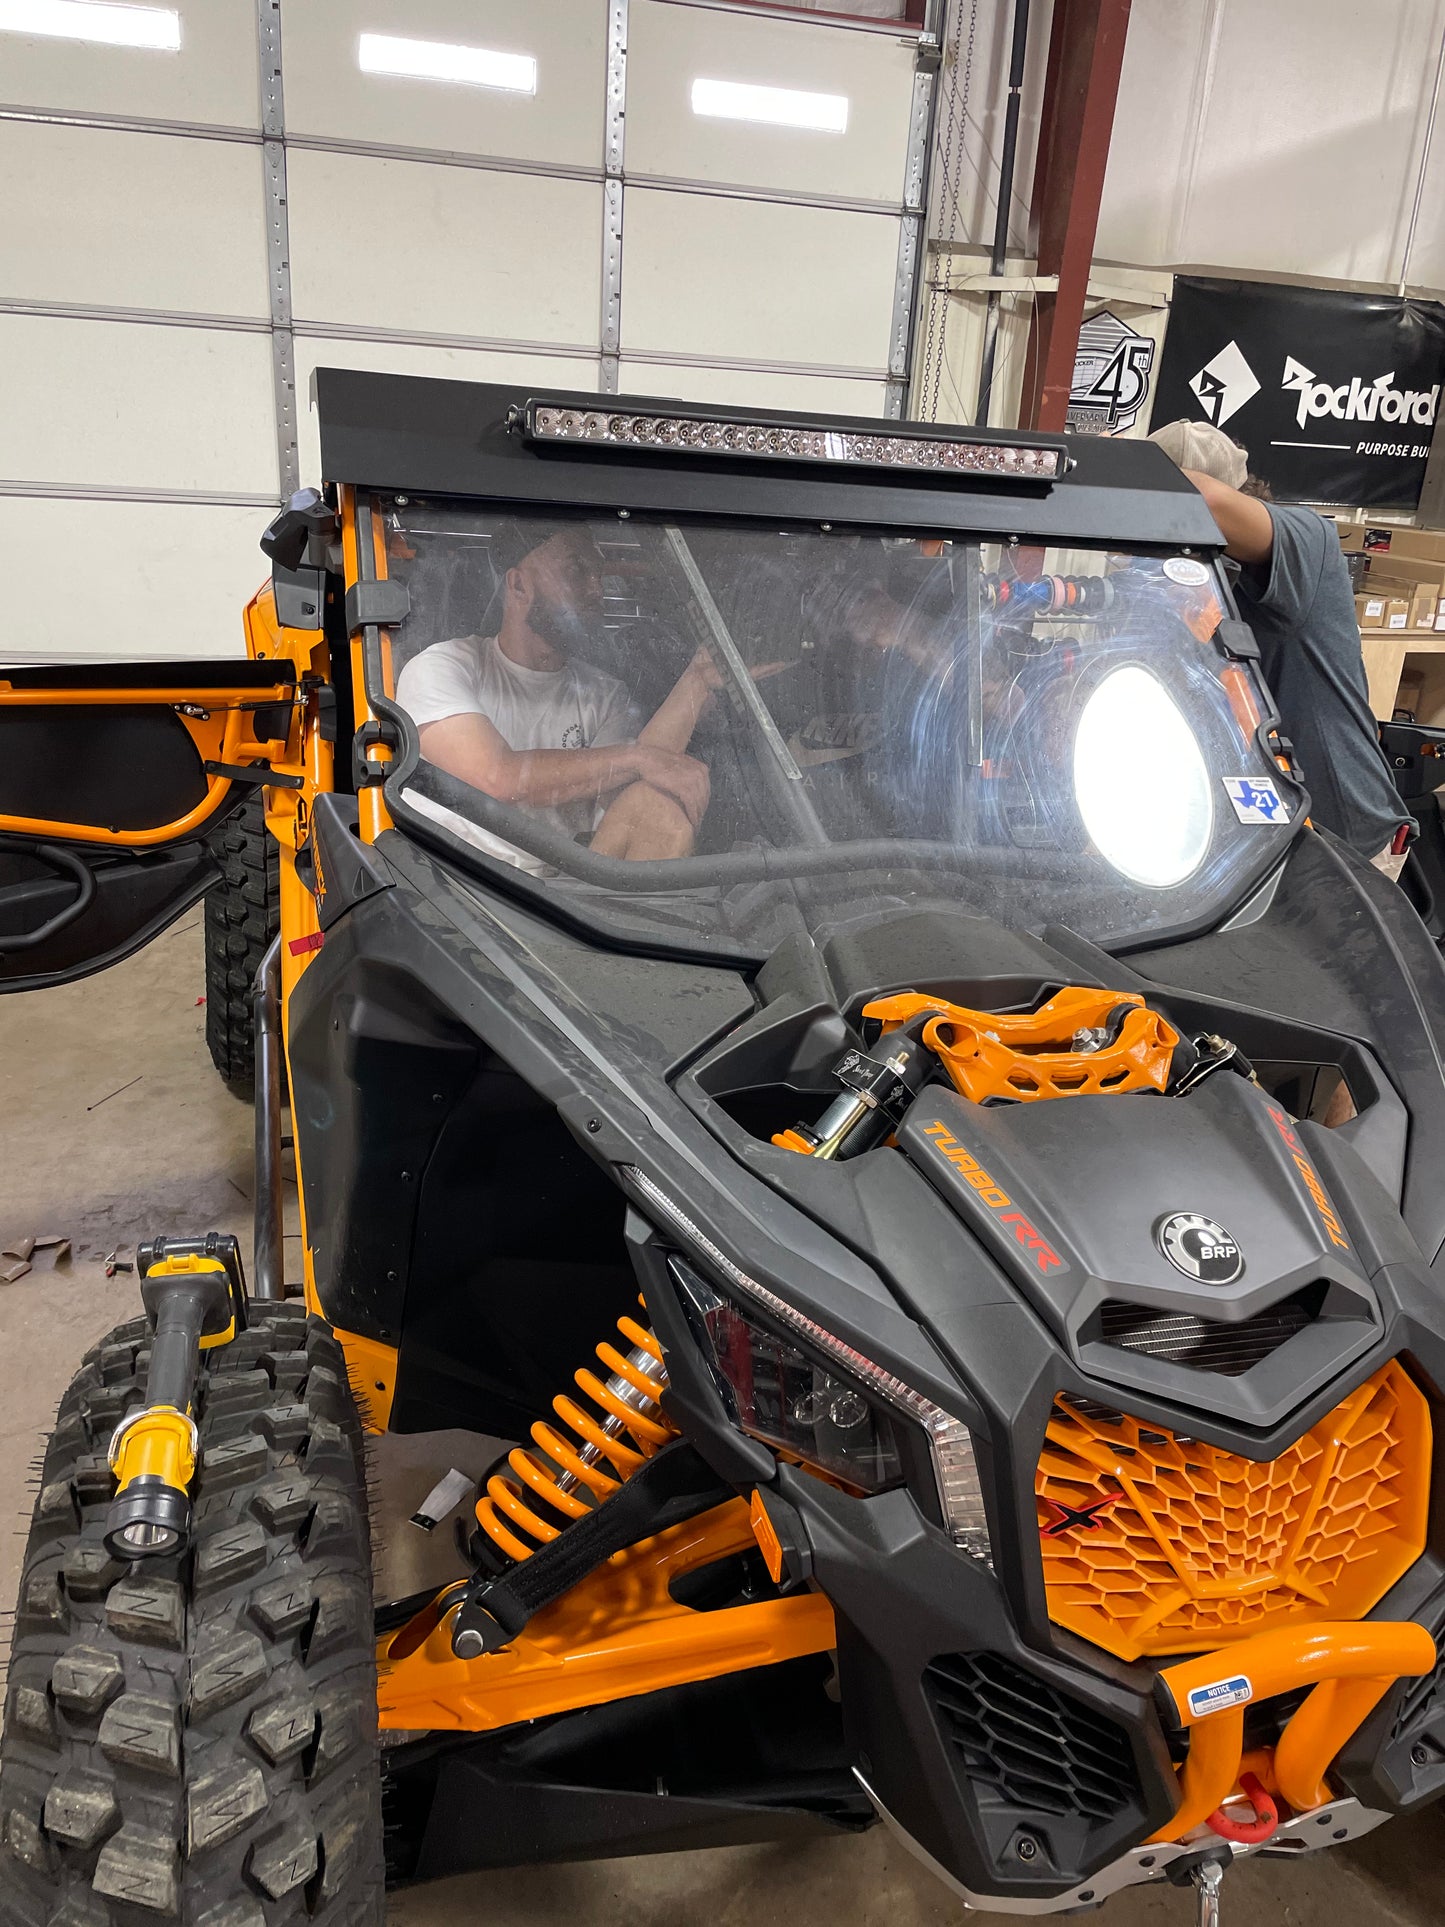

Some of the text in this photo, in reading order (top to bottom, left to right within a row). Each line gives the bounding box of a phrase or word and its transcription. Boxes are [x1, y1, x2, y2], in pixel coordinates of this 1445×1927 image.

[1281, 355, 1440, 431] Rockford
[1356, 441, 1410, 457] PURPOSE
[1251, 791, 1274, 808] 21
[923, 1121, 1062, 1273] TURBO RR
[1292, 1153, 1349, 1250] TURBO
[1200, 1246, 1237, 1260] BRP
[1207, 1684, 1231, 1698] NOTICE
